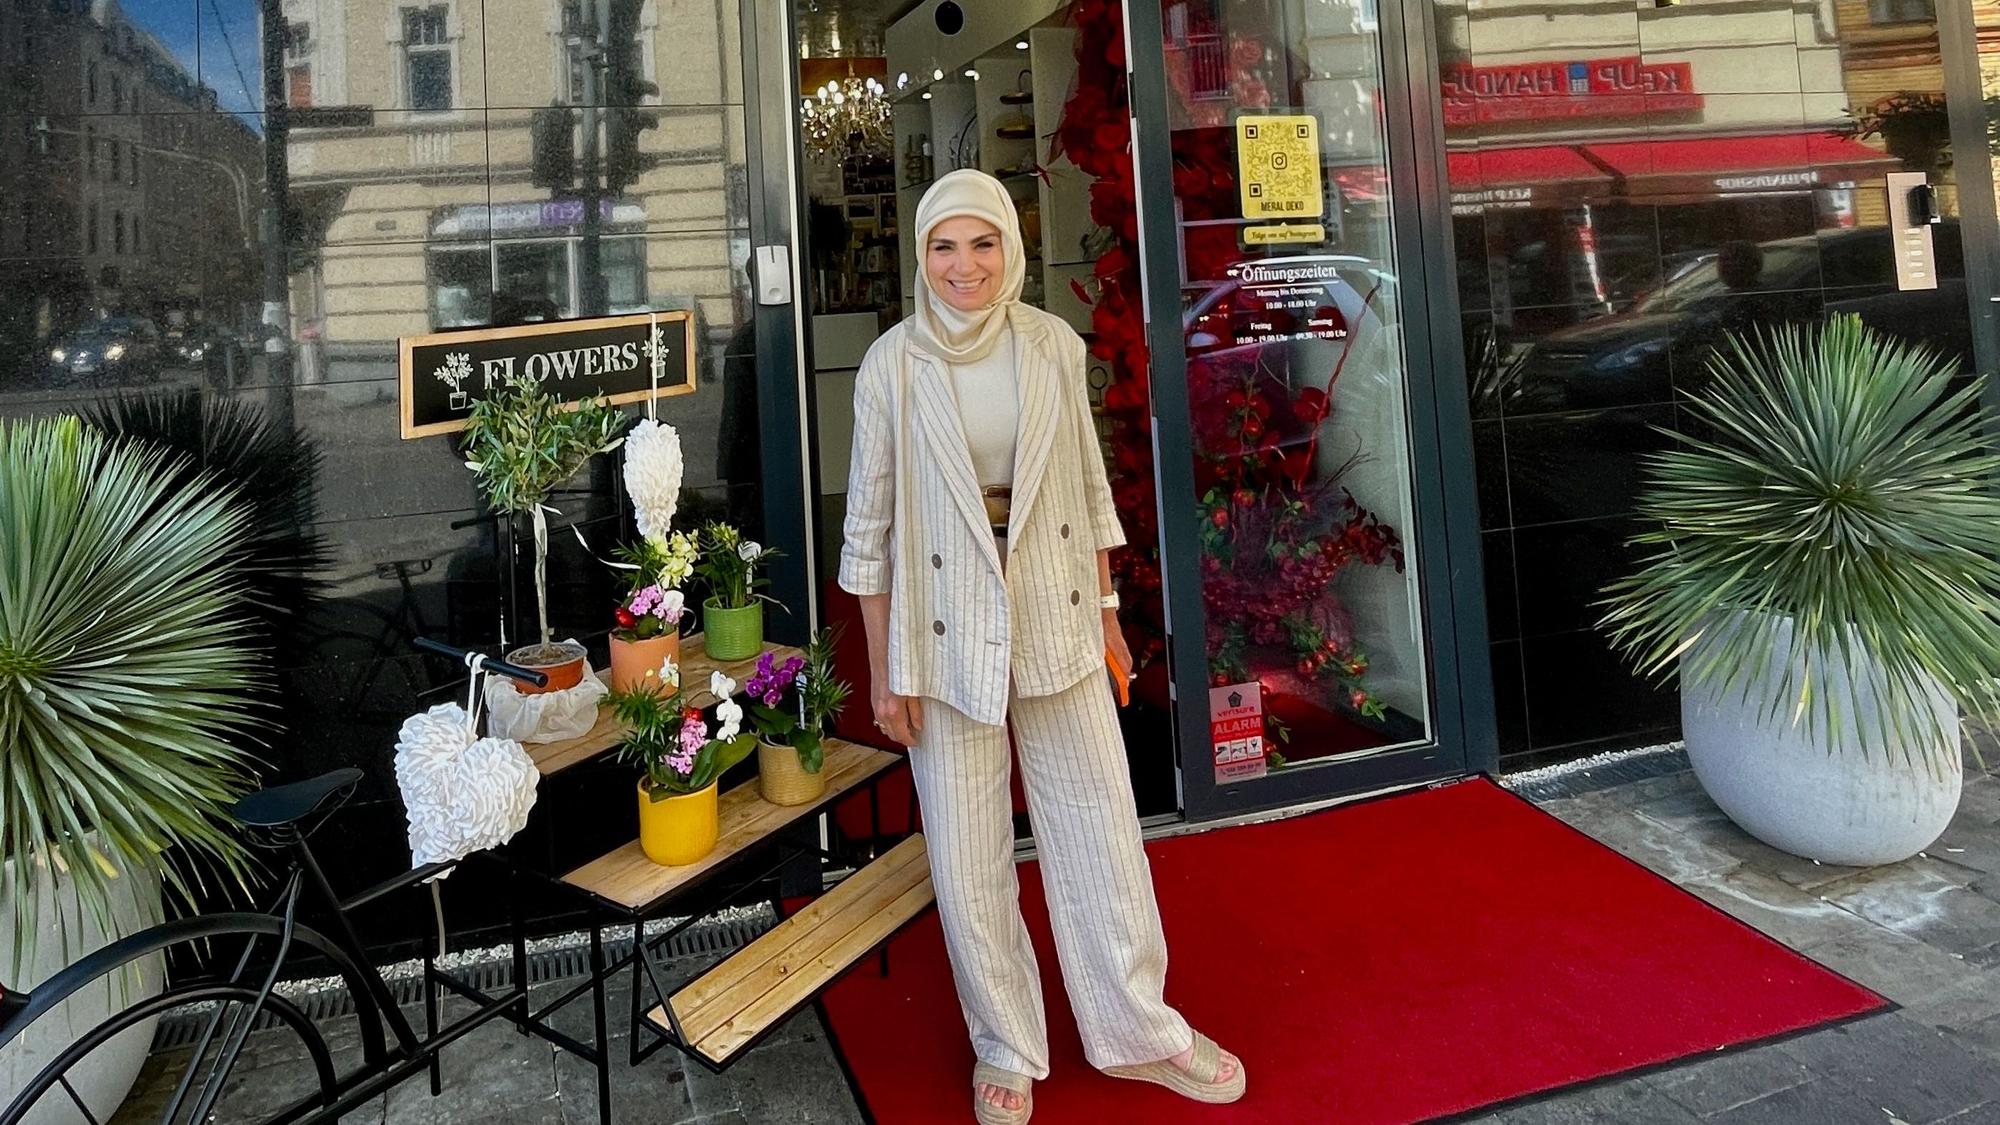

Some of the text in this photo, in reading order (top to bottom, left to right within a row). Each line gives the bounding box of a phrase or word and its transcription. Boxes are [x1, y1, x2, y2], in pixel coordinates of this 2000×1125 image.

[1260, 201, 1304, 212] MERAL DEKO
[1241, 264, 1337, 283] Öffnungszeiten
[1305, 299, 1317, 308] Uhr
[1250, 322, 1272, 331] Freitag
[1276, 333, 1288, 342] Uhr
[1335, 329, 1347, 338] Uhr
[480, 342, 639, 390] FLOWERS
[1214, 717, 1261, 735] ALARM
